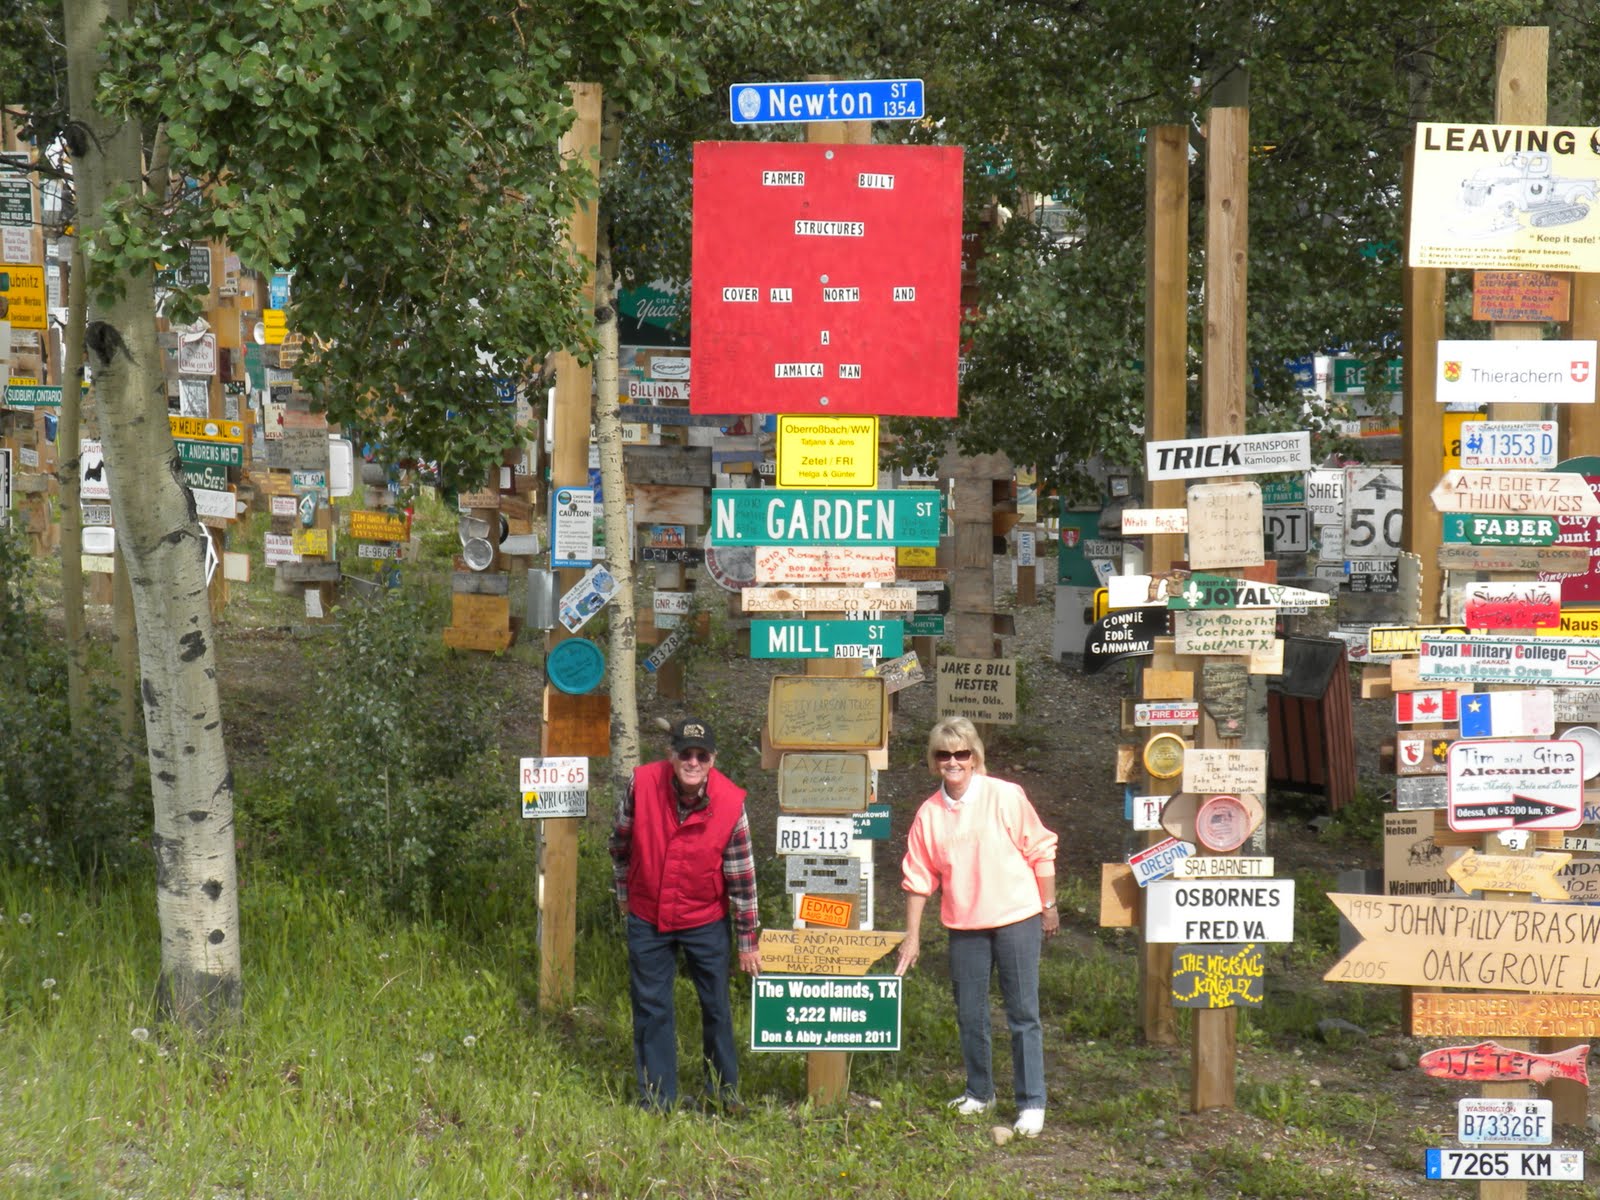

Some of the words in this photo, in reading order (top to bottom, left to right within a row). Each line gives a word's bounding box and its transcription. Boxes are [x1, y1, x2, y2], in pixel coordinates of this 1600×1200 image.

[769, 87, 873, 118] Newton
[891, 83, 908, 99] ST
[883, 101, 916, 116] 1354
[1424, 127, 1577, 155] LEAVING
[763, 171, 804, 185] FARMER
[859, 174, 894, 189] BUILT
[795, 221, 864, 236] STRUCTURES
[1536, 234, 1561, 245] Keep
[1564, 235, 1570, 243] it
[724, 288, 758, 302] COVER
[771, 289, 791, 302] ALL
[824, 287, 859, 301] NORTH
[894, 287, 915, 301] AND
[822, 331, 829, 344] A
[776, 364, 823, 378] JAMAICA
[840, 365, 861, 378] MAN
[1471, 368, 1563, 384] Thierachern
[837, 438, 855, 447] Jens
[1490, 433, 1535, 457] 1353
[1541, 433, 1553, 456] D
[189, 445, 220, 461] ANDREWS
[220, 448, 231, 462] MB
[801, 456, 828, 467] Zetel
[835, 457, 854, 467] FRI
[1156, 442, 1242, 471] TRICK
[1243, 439, 1300, 452] TRANSPORT
[1244, 454, 1289, 466] Kamloops,
[1290, 453, 1301, 463] BC
[1482, 456, 1535, 465] ALABAMA
[1310, 505, 1335, 514] SPEED
[716, 498, 742, 540] N.
[766, 498, 896, 540] GARDEN
[916, 502, 933, 518] ST
[1557, 515, 1592, 529] City
[1350, 508, 1403, 549] 50
[1474, 518, 1554, 537] FABER
[1202, 588, 1271, 606] JOYAL
[768, 625, 829, 654] MILL
[868, 625, 886, 640] ST
[1091, 640, 1150, 654] GANNAWAY
[1421, 643, 1458, 659] Royal
[1460, 643, 1513, 660] Military
[1514, 645, 1568, 661] College
[941, 662, 971, 675] JAKE
[974, 663, 982, 675] &
[986, 664, 1011, 676] BILL
[955, 678, 998, 692] HESTER
[1151, 710, 1171, 719] FIRE
[1173, 709, 1199, 718] DEPT.
[1458, 747, 1495, 765] Tim
[1503, 754, 1523, 764] and
[1533, 746, 1576, 765] Gina
[790, 758, 858, 775] AXEL
[1459, 766, 1576, 777] Alexander
[523, 768, 585, 785] R310-65
[1456, 808, 1486, 818] Odessa,
[1487, 807, 1499, 816] ON
[1504, 806, 1527, 815] 5200
[1528, 807, 1544, 816] km,
[1545, 806, 1556, 815] SE
[1386, 826, 1417, 836] Nelson
[781, 830, 811, 849] RB1
[818, 831, 849, 850] 113
[1140, 843, 1189, 876] OREGON
[1185, 859, 1207, 875] SRA
[1210, 859, 1263, 875] BARNETT
[1175, 888, 1281, 908] OSBORNES
[805, 911, 822, 920] AUG
[806, 901, 844, 916] EDMO
[1349, 900, 1383, 920] 1995
[1384, 903, 1447, 937] JOHN
[763, 933, 800, 944] WAYNE
[803, 935, 826, 944] AND
[829, 935, 887, 947] PATRICIA
[794, 945, 840, 955] BAJCAR
[1341, 960, 1390, 979] 2005
[1423, 949, 1474, 982] OAK
[1478, 952, 1570, 989] GROVE
[757, 981, 784, 998] The
[788, 981, 874, 1001] Woodlands,
[878, 981, 897, 998] TX
[786, 1006, 826, 1025] 3,222
[830, 1006, 867, 1023] Miles
[761, 1030, 783, 1043] Don
[785, 1030, 794, 1043] &
[796, 1030, 822, 1045] Abby
[824, 1030, 862, 1043] Jensen
[865, 1031, 892, 1043] 2011
[1464, 1114, 1546, 1138] B73326F
[1448, 1152, 1510, 1176] 7265
[1521, 1153, 1552, 1176] KM
